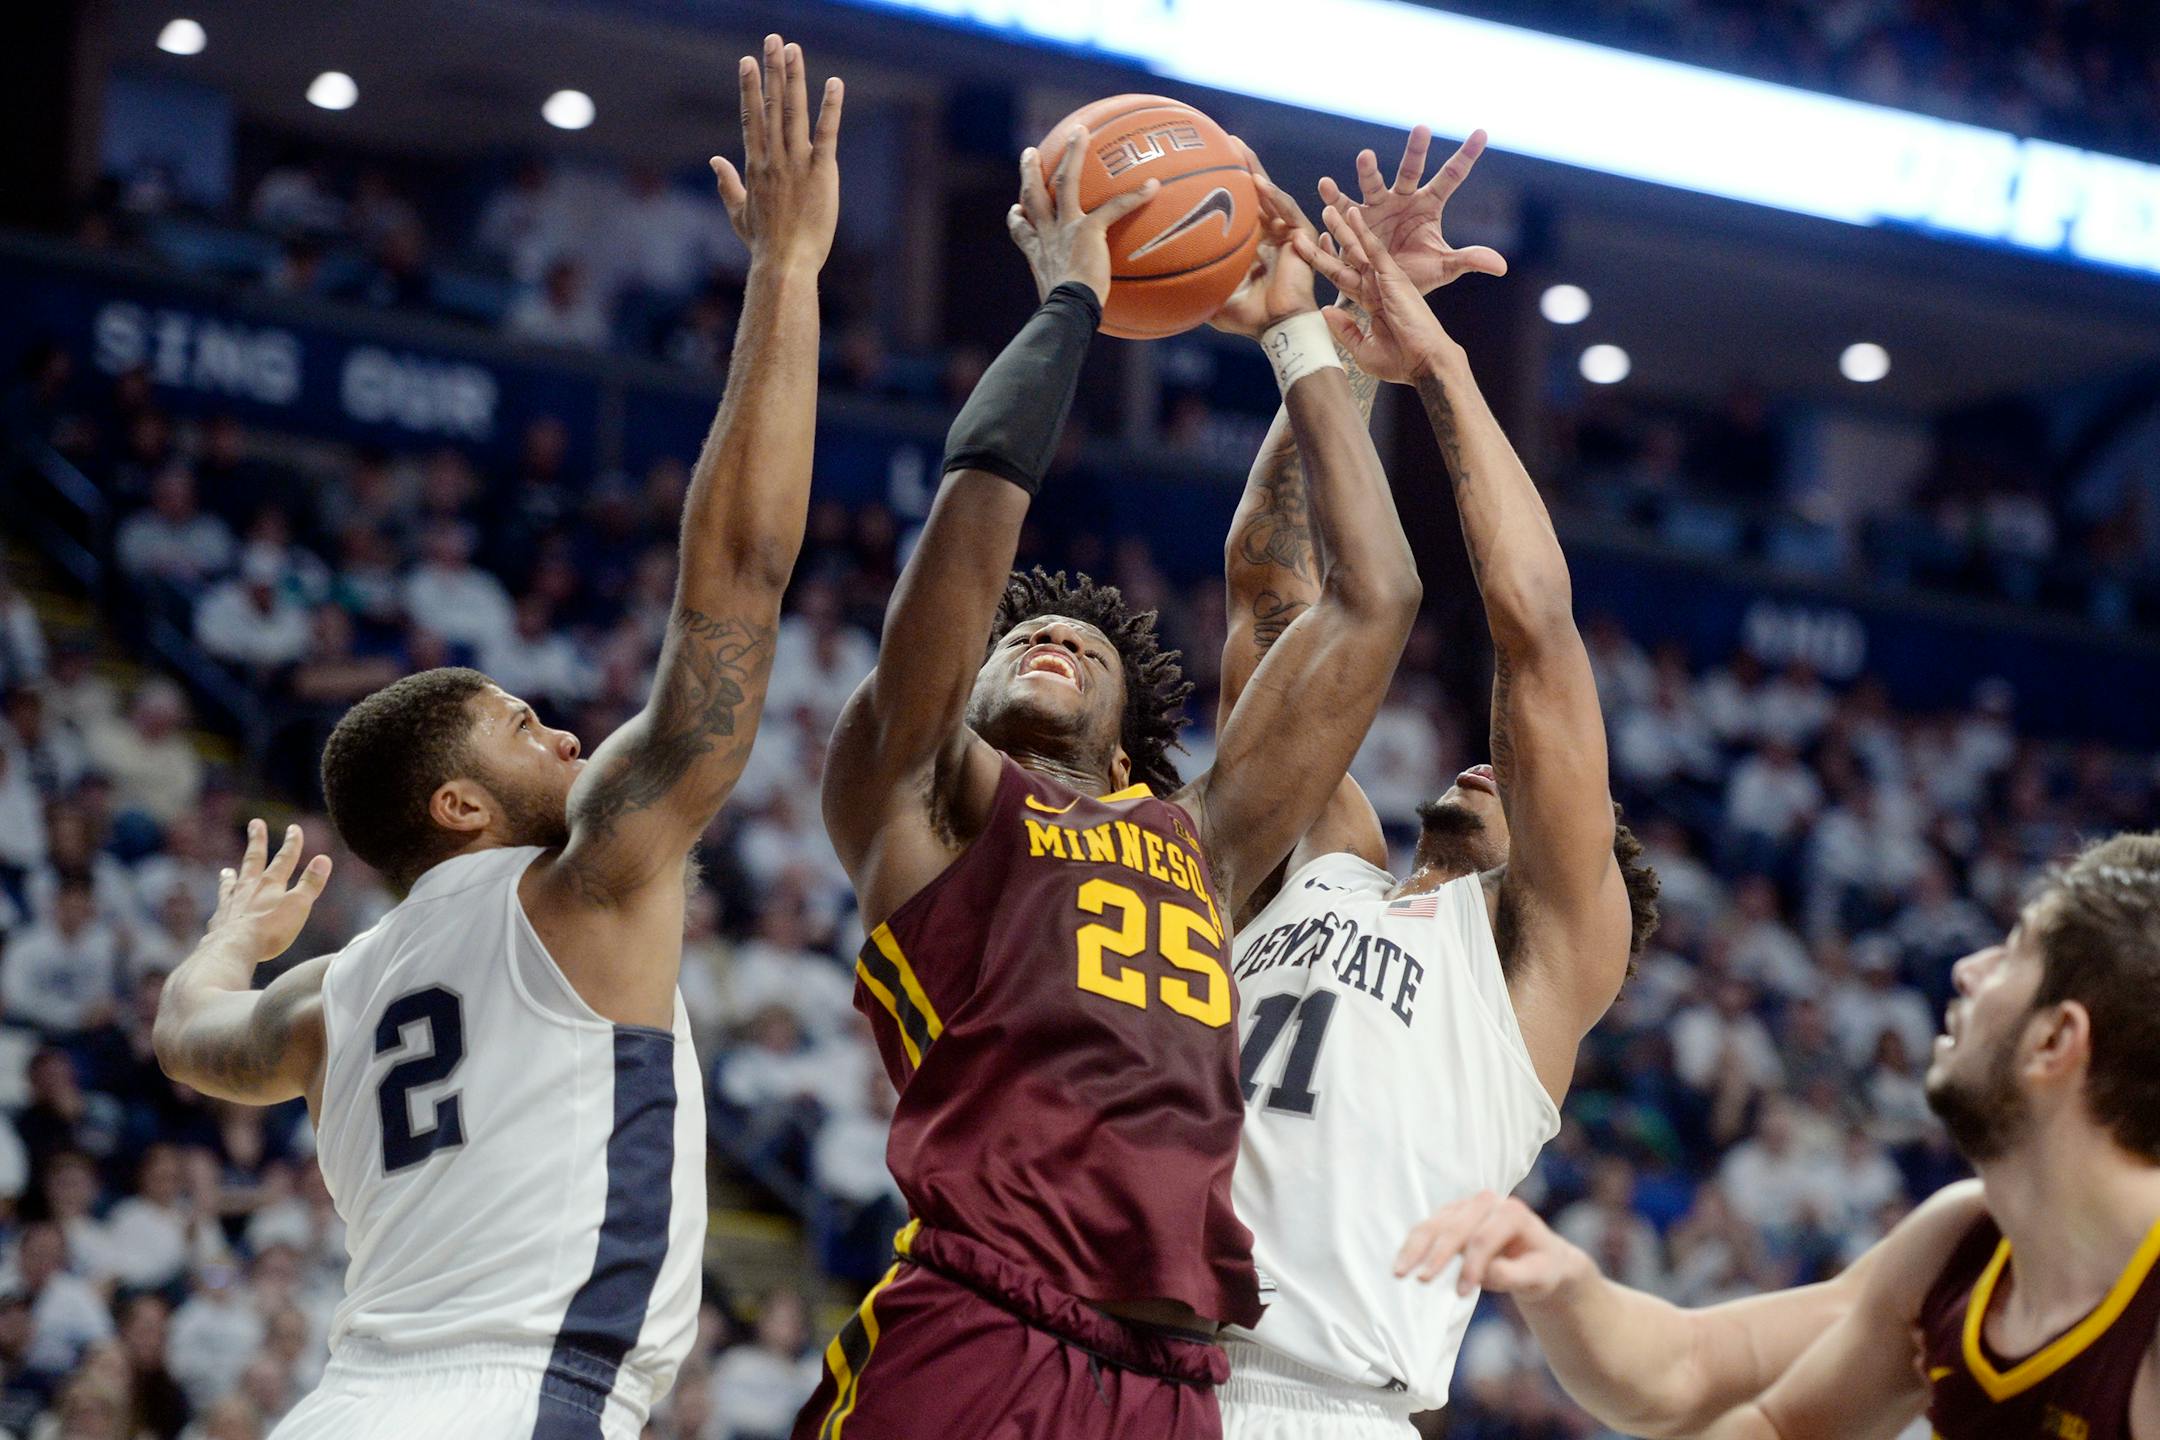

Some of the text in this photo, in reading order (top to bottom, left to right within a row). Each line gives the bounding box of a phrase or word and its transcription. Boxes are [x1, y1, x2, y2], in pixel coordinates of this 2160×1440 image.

[1099, 127, 1205, 179] ELITE
[1024, 819, 1225, 941] MINNESO
[1077, 878, 1231, 1028] 25
[1309, 911, 1425, 1028] STATE
[374, 982, 469, 1178] 2
[1240, 988, 1341, 1120] 11
